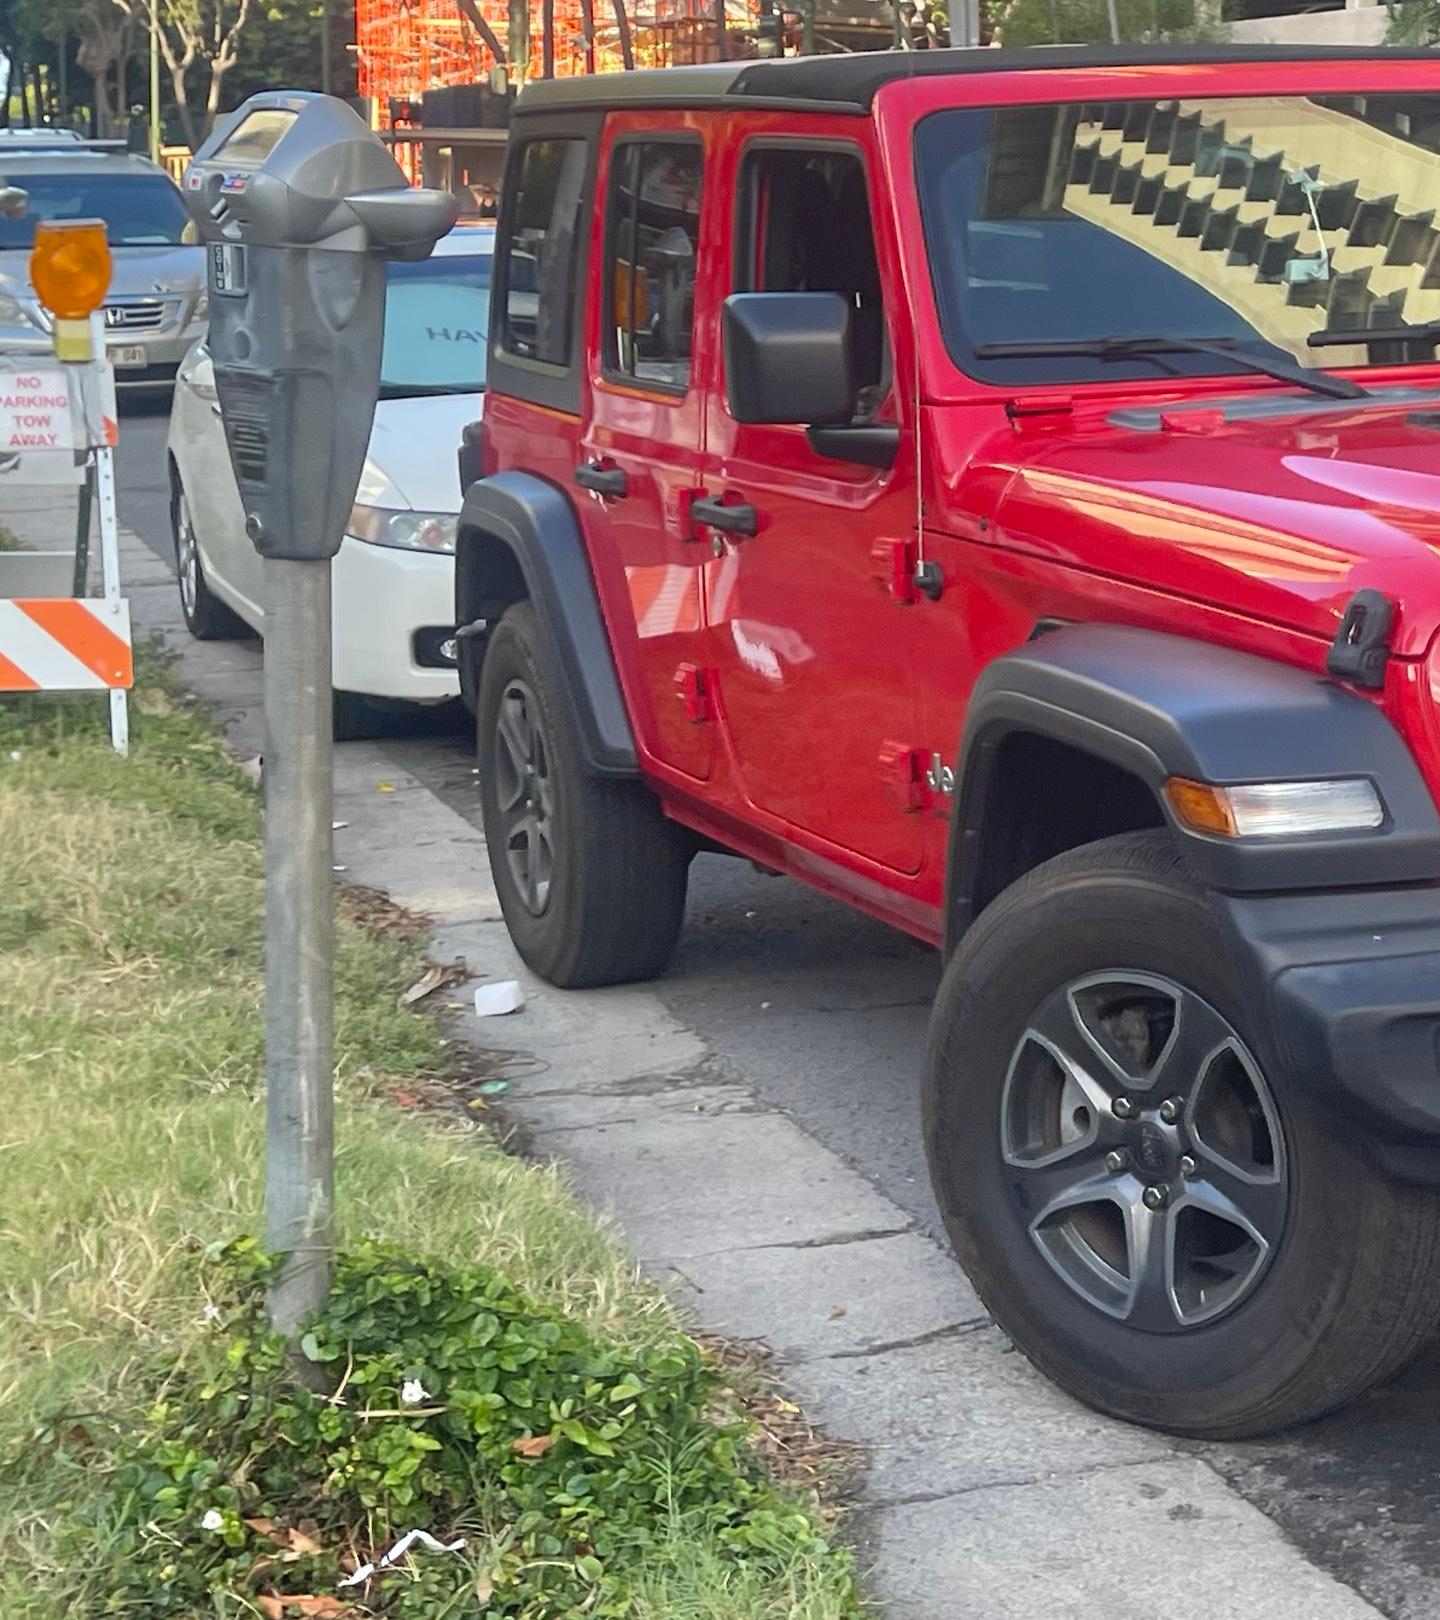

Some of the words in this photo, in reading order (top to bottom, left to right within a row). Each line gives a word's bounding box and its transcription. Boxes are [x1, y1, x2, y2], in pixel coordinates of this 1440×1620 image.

[16, 376, 42, 389] NO
[0, 395, 68, 408] ARKING
[12, 415, 51, 428] TOW
[9, 433, 57, 446] AWAY
